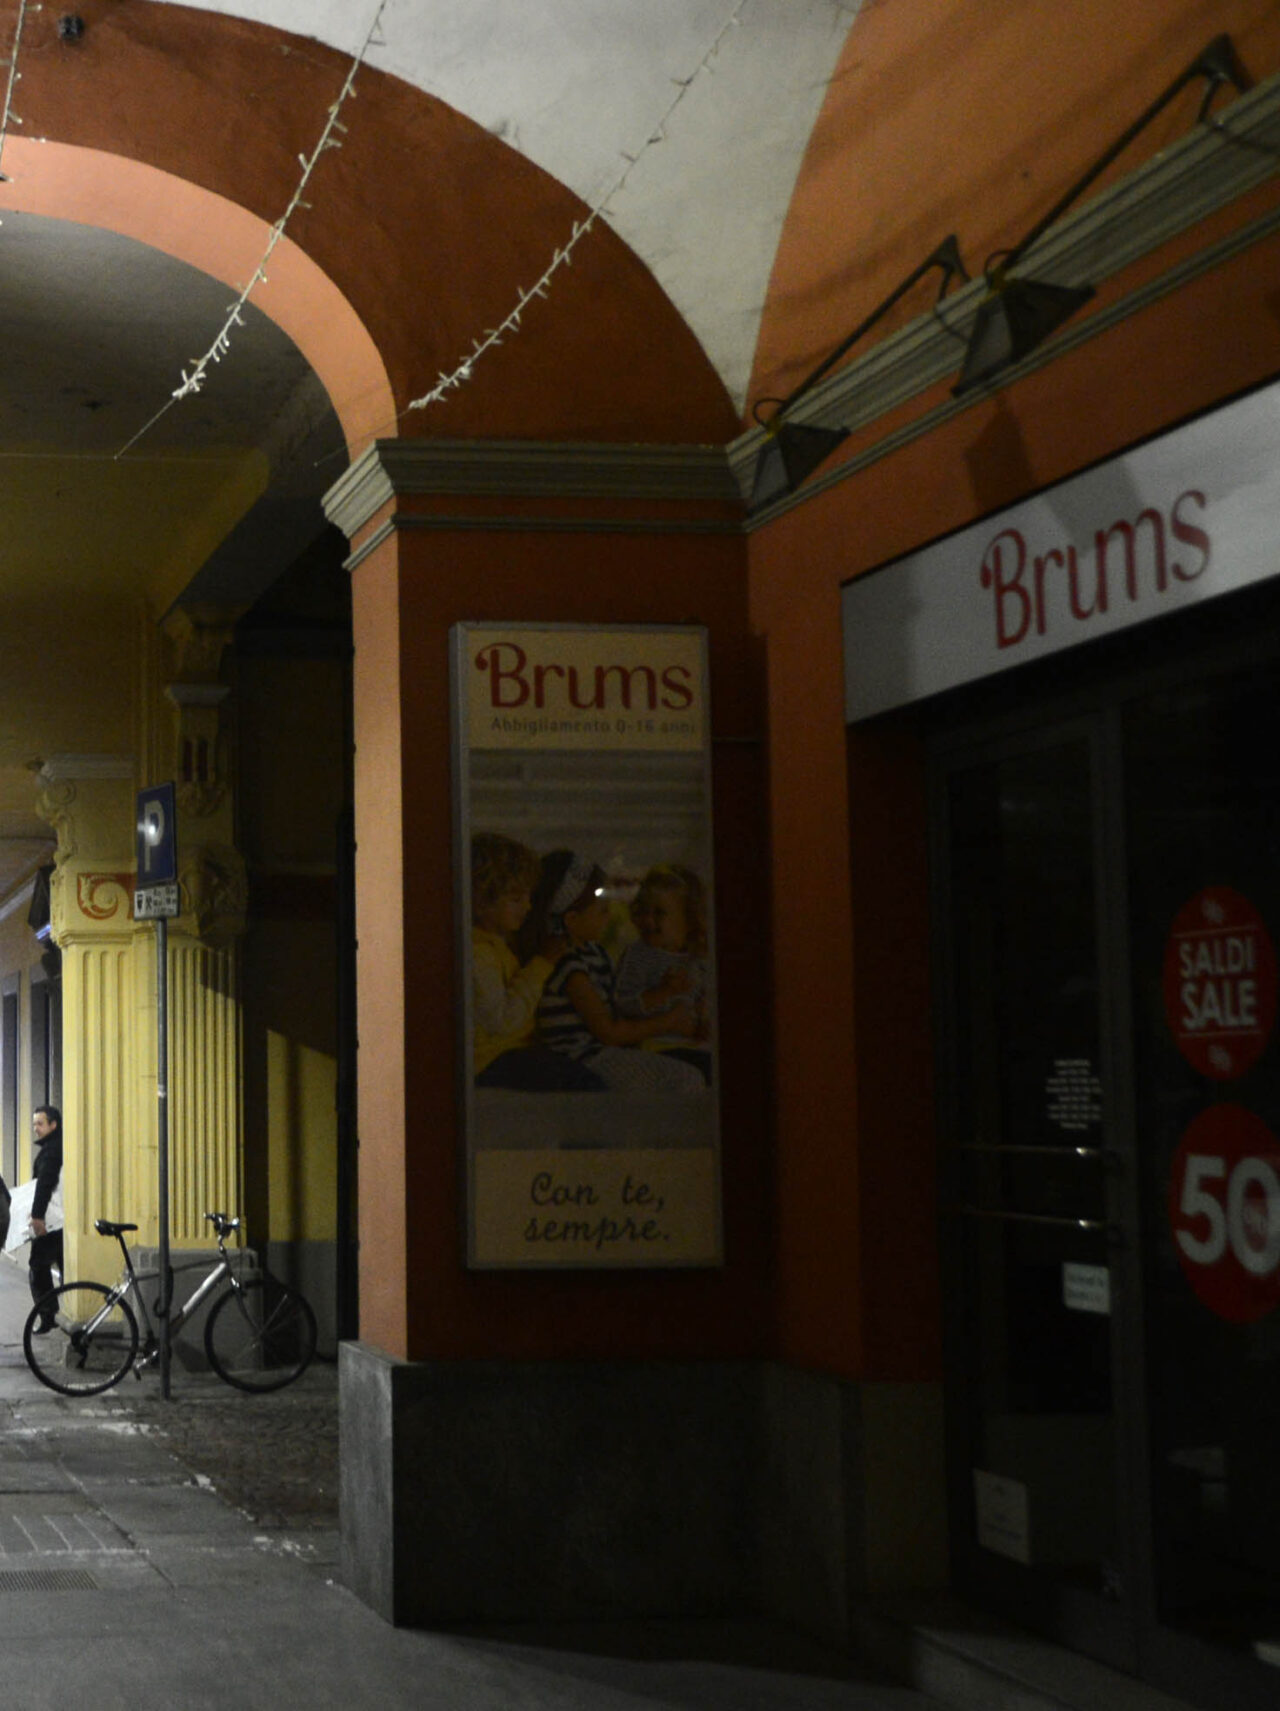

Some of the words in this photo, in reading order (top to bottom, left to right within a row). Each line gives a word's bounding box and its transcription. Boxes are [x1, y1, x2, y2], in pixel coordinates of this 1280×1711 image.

[981, 490, 1211, 648] Brums
[475, 642, 694, 710] Brums
[491, 716, 610, 736] Abbigliamento
[662, 720, 696, 734] anni
[144, 800, 165, 873] P
[1178, 935, 1256, 979] SALDI
[1180, 979, 1258, 1031] SALE
[531, 1171, 600, 1206] Con
[622, 1174, 664, 1211] te,
[1175, 1154, 1280, 1278] 50
[524, 1216, 669, 1249] sempre.
